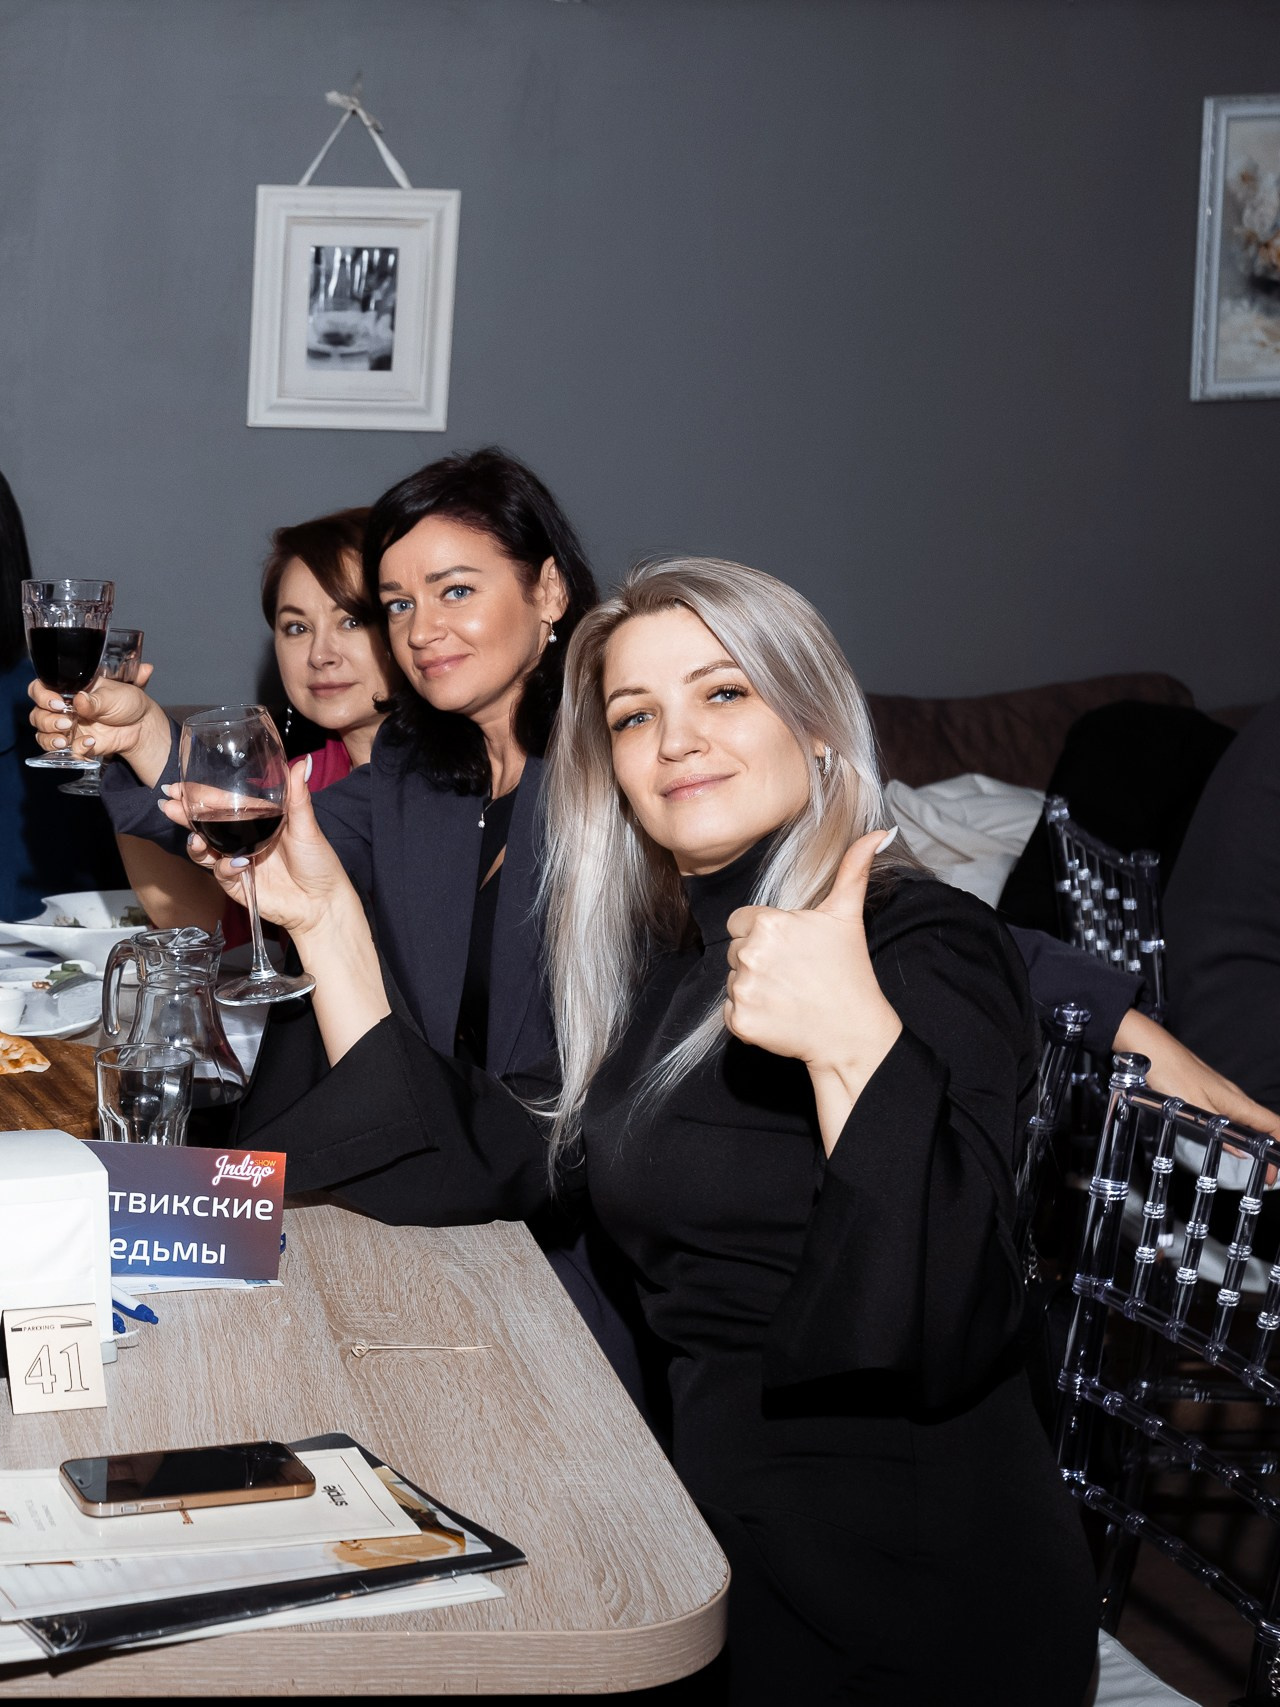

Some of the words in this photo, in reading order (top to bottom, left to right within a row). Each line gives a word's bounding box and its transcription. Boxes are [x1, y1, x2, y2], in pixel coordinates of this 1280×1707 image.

[212, 1154, 275, 1188] Indigo
[109, 1191, 274, 1221] твикские
[110, 1237, 226, 1266] едьмы
[24, 1342, 90, 1395] 41
